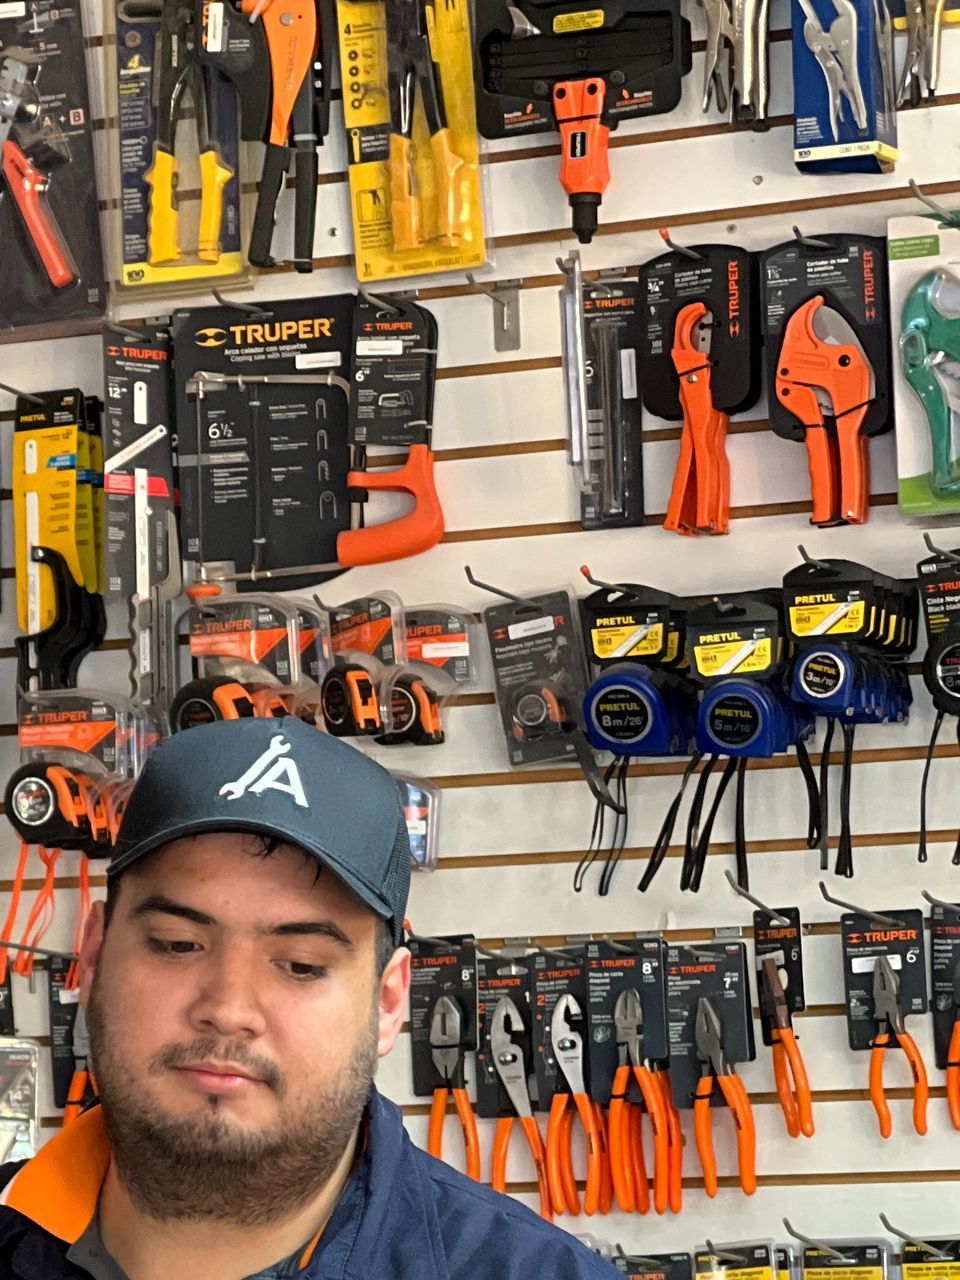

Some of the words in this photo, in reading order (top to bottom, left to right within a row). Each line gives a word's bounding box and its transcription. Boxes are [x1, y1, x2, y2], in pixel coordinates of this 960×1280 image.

[863, 250, 874, 304] TRUPER
[728, 260, 739, 318] TRUPER
[596, 298, 635, 308] TRUPER
[230, 318, 332, 344] TRUPER
[375, 322, 413, 331] TRUPER
[122, 347, 168, 360] TRUPER
[794, 593, 836, 605] PRETUL
[205, 620, 252, 632] TRUPER
[596, 616, 636, 626] PRETUL
[699, 632, 741, 644] PRETUL
[808, 662, 837, 675] PRETUL
[600, 703, 640, 712] PRETUL
[38, 711, 88, 722] TRUPER
[714, 708, 752, 719] PRETUL
[767, 928, 797, 938] TRUPER
[864, 930, 916, 943] TRUPER
[422, 956, 457, 966] TRUPER
[601, 959, 635, 968] TRUPER
[547, 968, 581, 979] TRUPER
[680, 965, 716, 974] TRUPER
[488, 978, 521, 988] TRUPER
[628, 1273, 665, 1280] TRUPER
